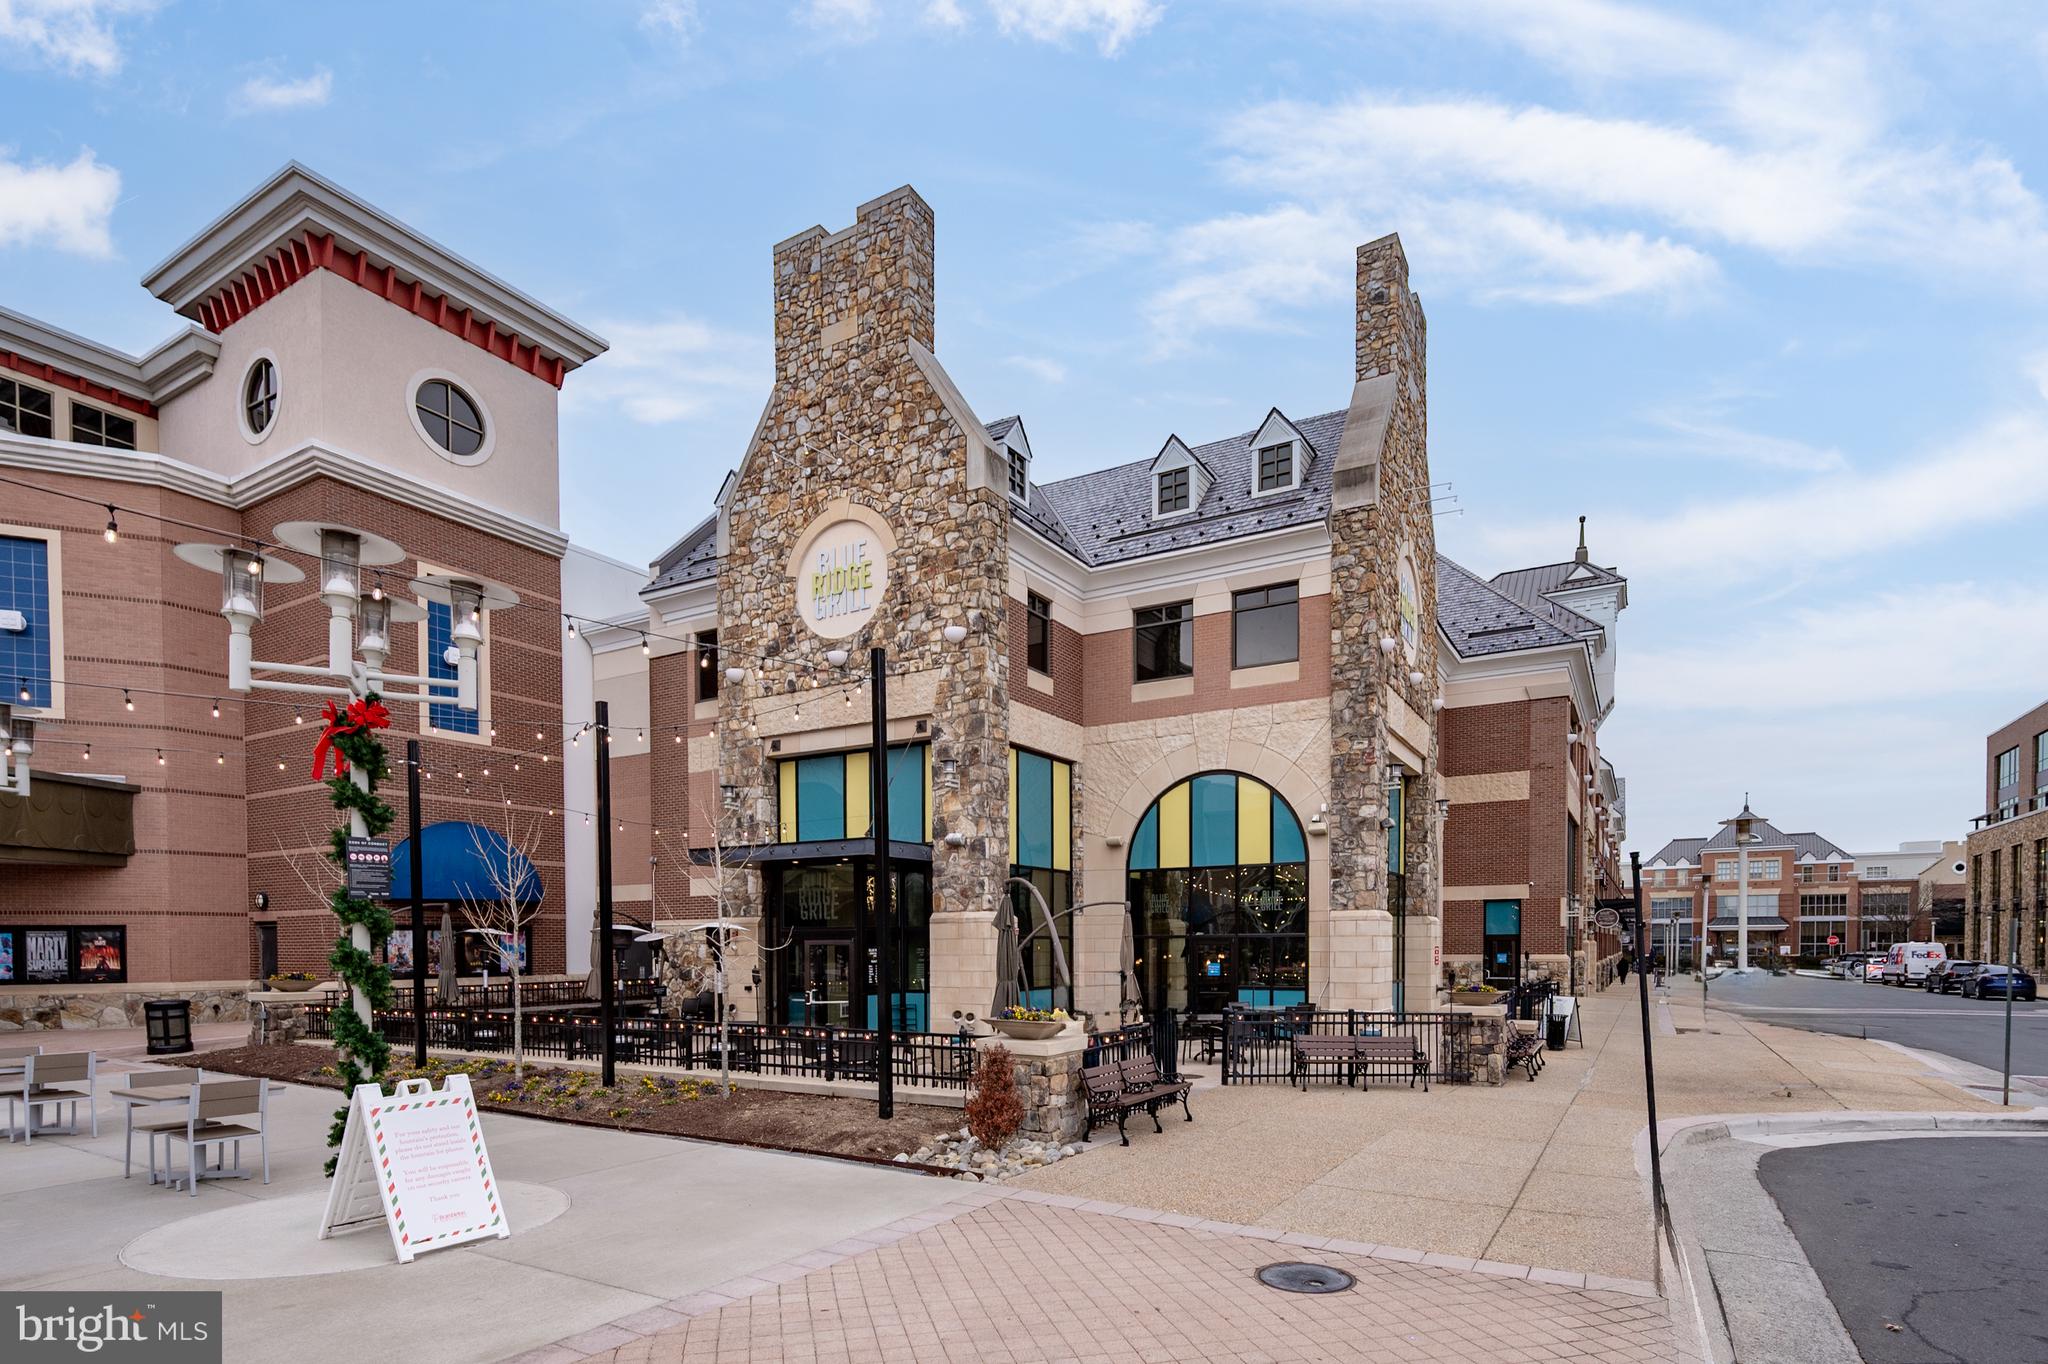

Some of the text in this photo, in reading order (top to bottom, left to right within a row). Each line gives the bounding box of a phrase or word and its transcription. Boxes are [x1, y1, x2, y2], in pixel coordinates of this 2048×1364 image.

[819, 539, 867, 574] BLUE
[811, 560, 873, 600] RIDGE
[814, 588, 871, 621] GRILL
[800, 903, 839, 921] GRILL
[27, 937, 67, 960] MARTY
[1911, 950, 1941, 959] FedEx
[27, 959, 68, 971] SUPREME
